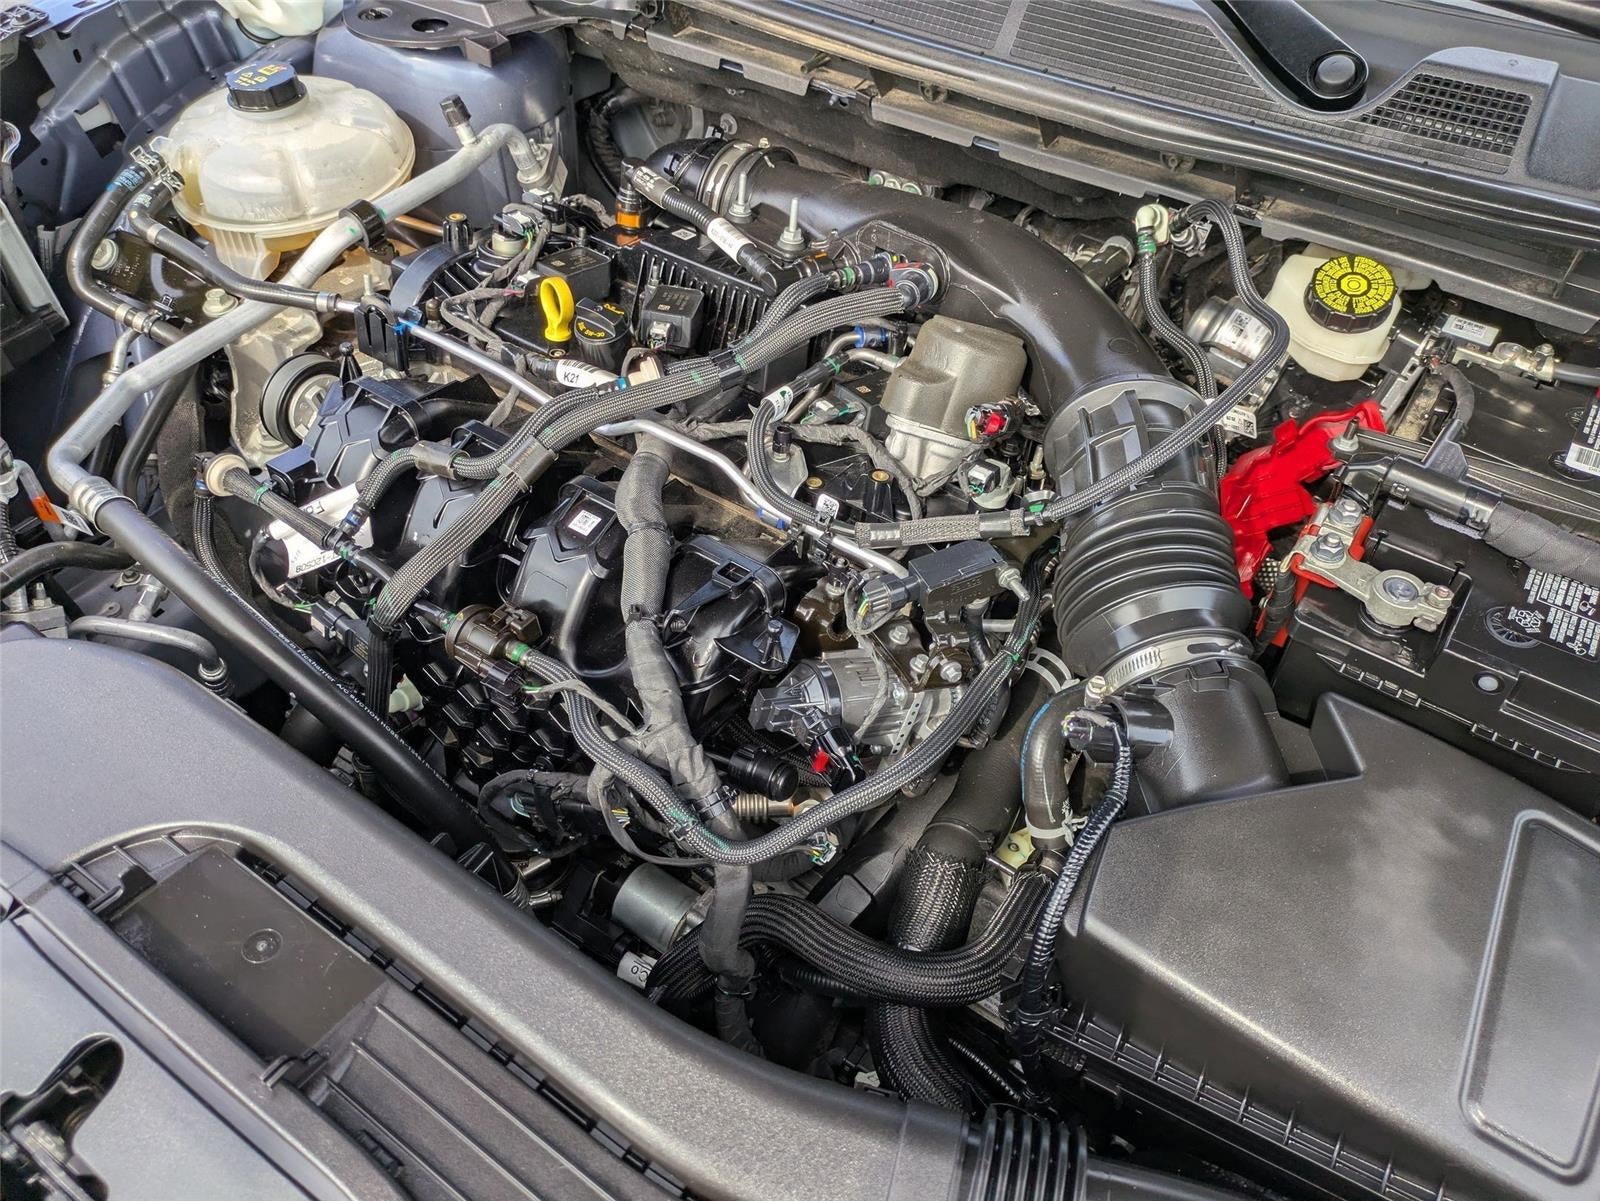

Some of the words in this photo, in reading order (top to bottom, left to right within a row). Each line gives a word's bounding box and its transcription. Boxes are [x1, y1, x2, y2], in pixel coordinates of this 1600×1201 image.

[563, 371, 580, 384] K21
[336, 682, 350, 695] A/C
[349, 693, 380, 722] SUCTION
[380, 720, 400, 740] HOSE
